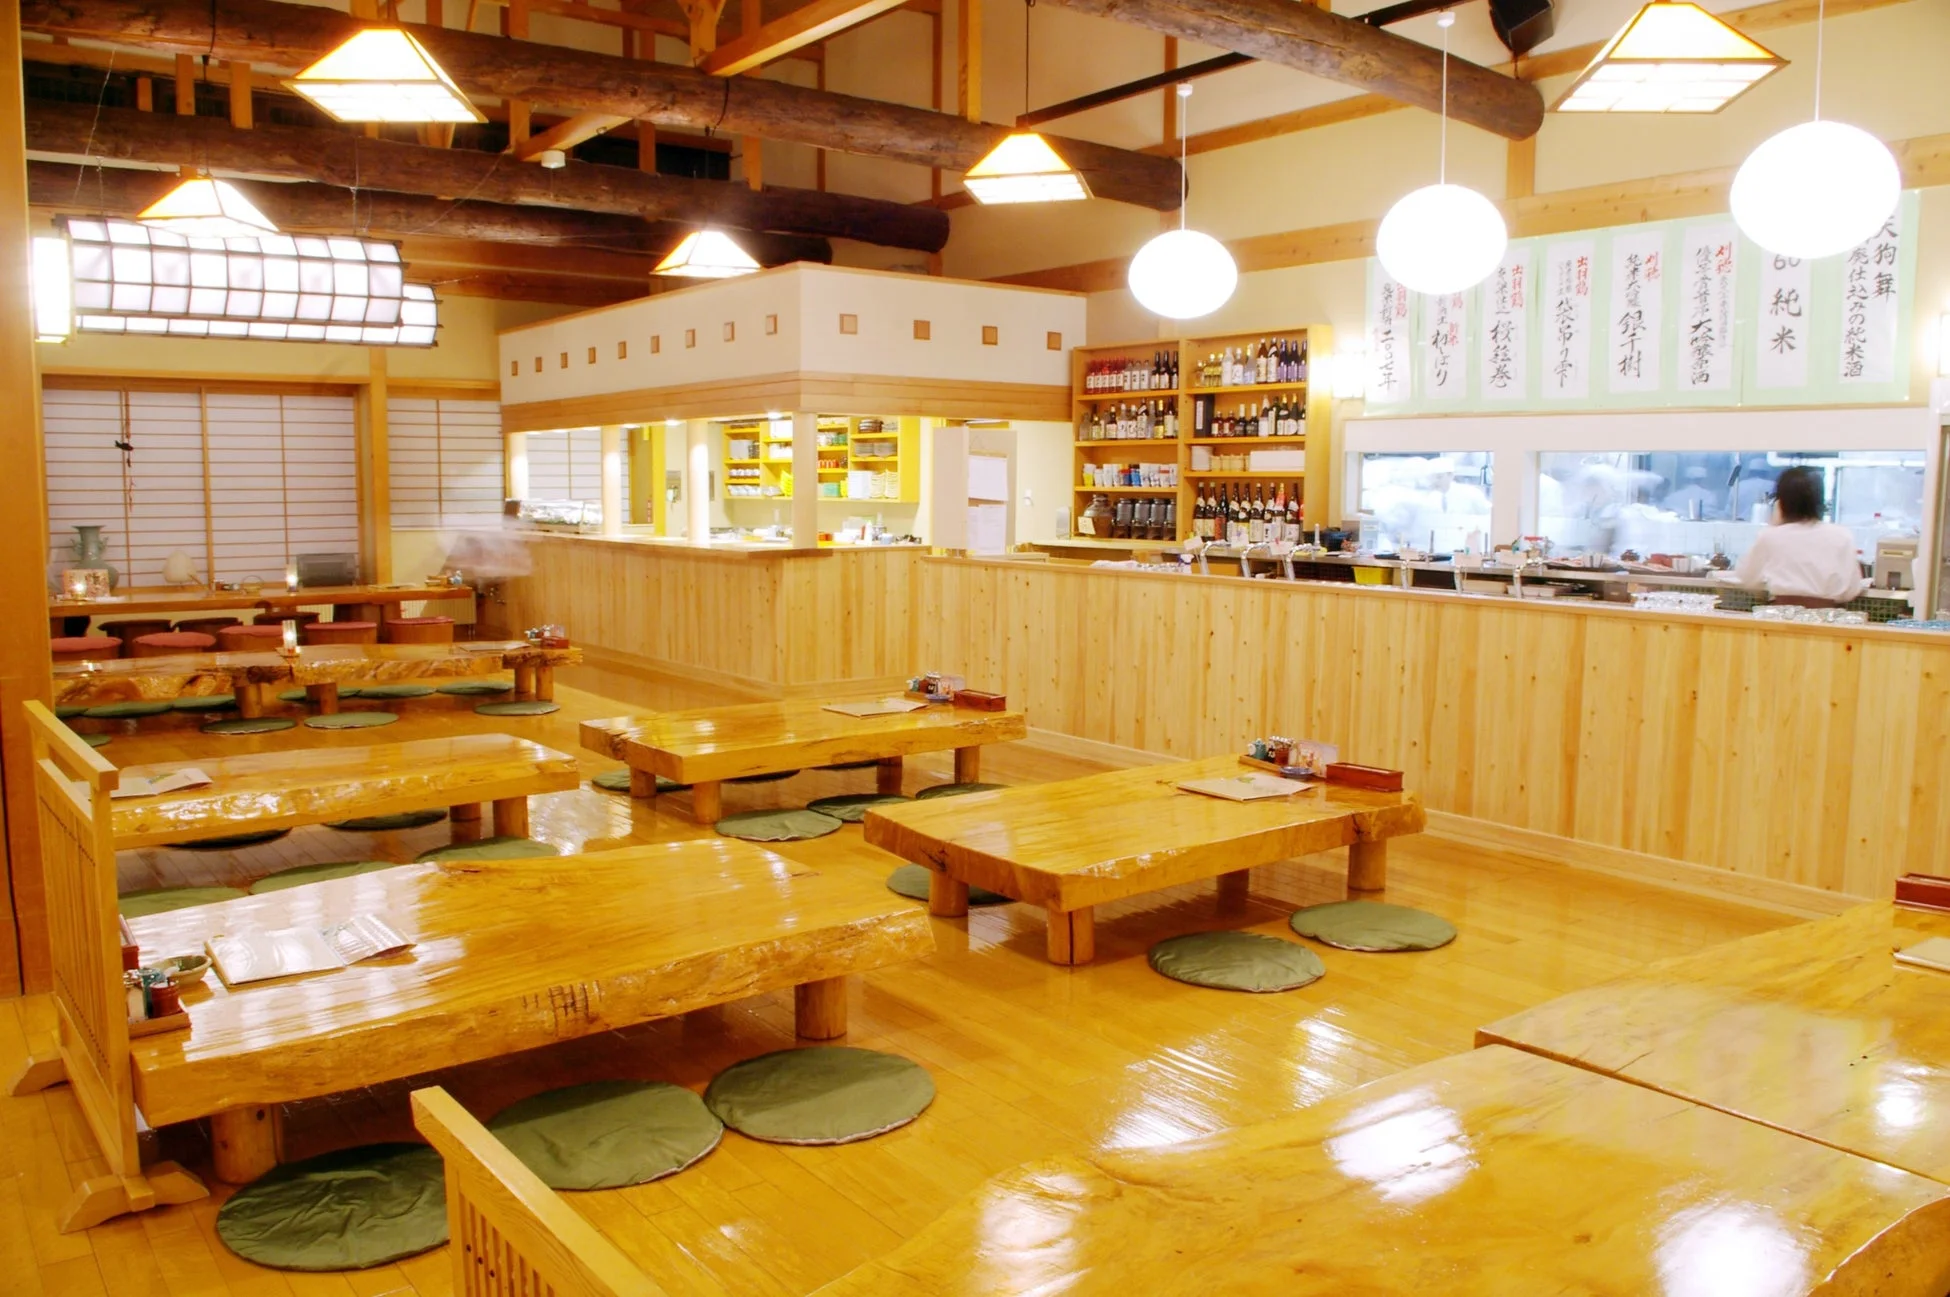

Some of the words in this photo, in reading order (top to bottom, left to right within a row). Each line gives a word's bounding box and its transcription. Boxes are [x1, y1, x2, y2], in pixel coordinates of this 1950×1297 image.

[1843, 240, 1871, 379] 廃仕込みの純米酒
